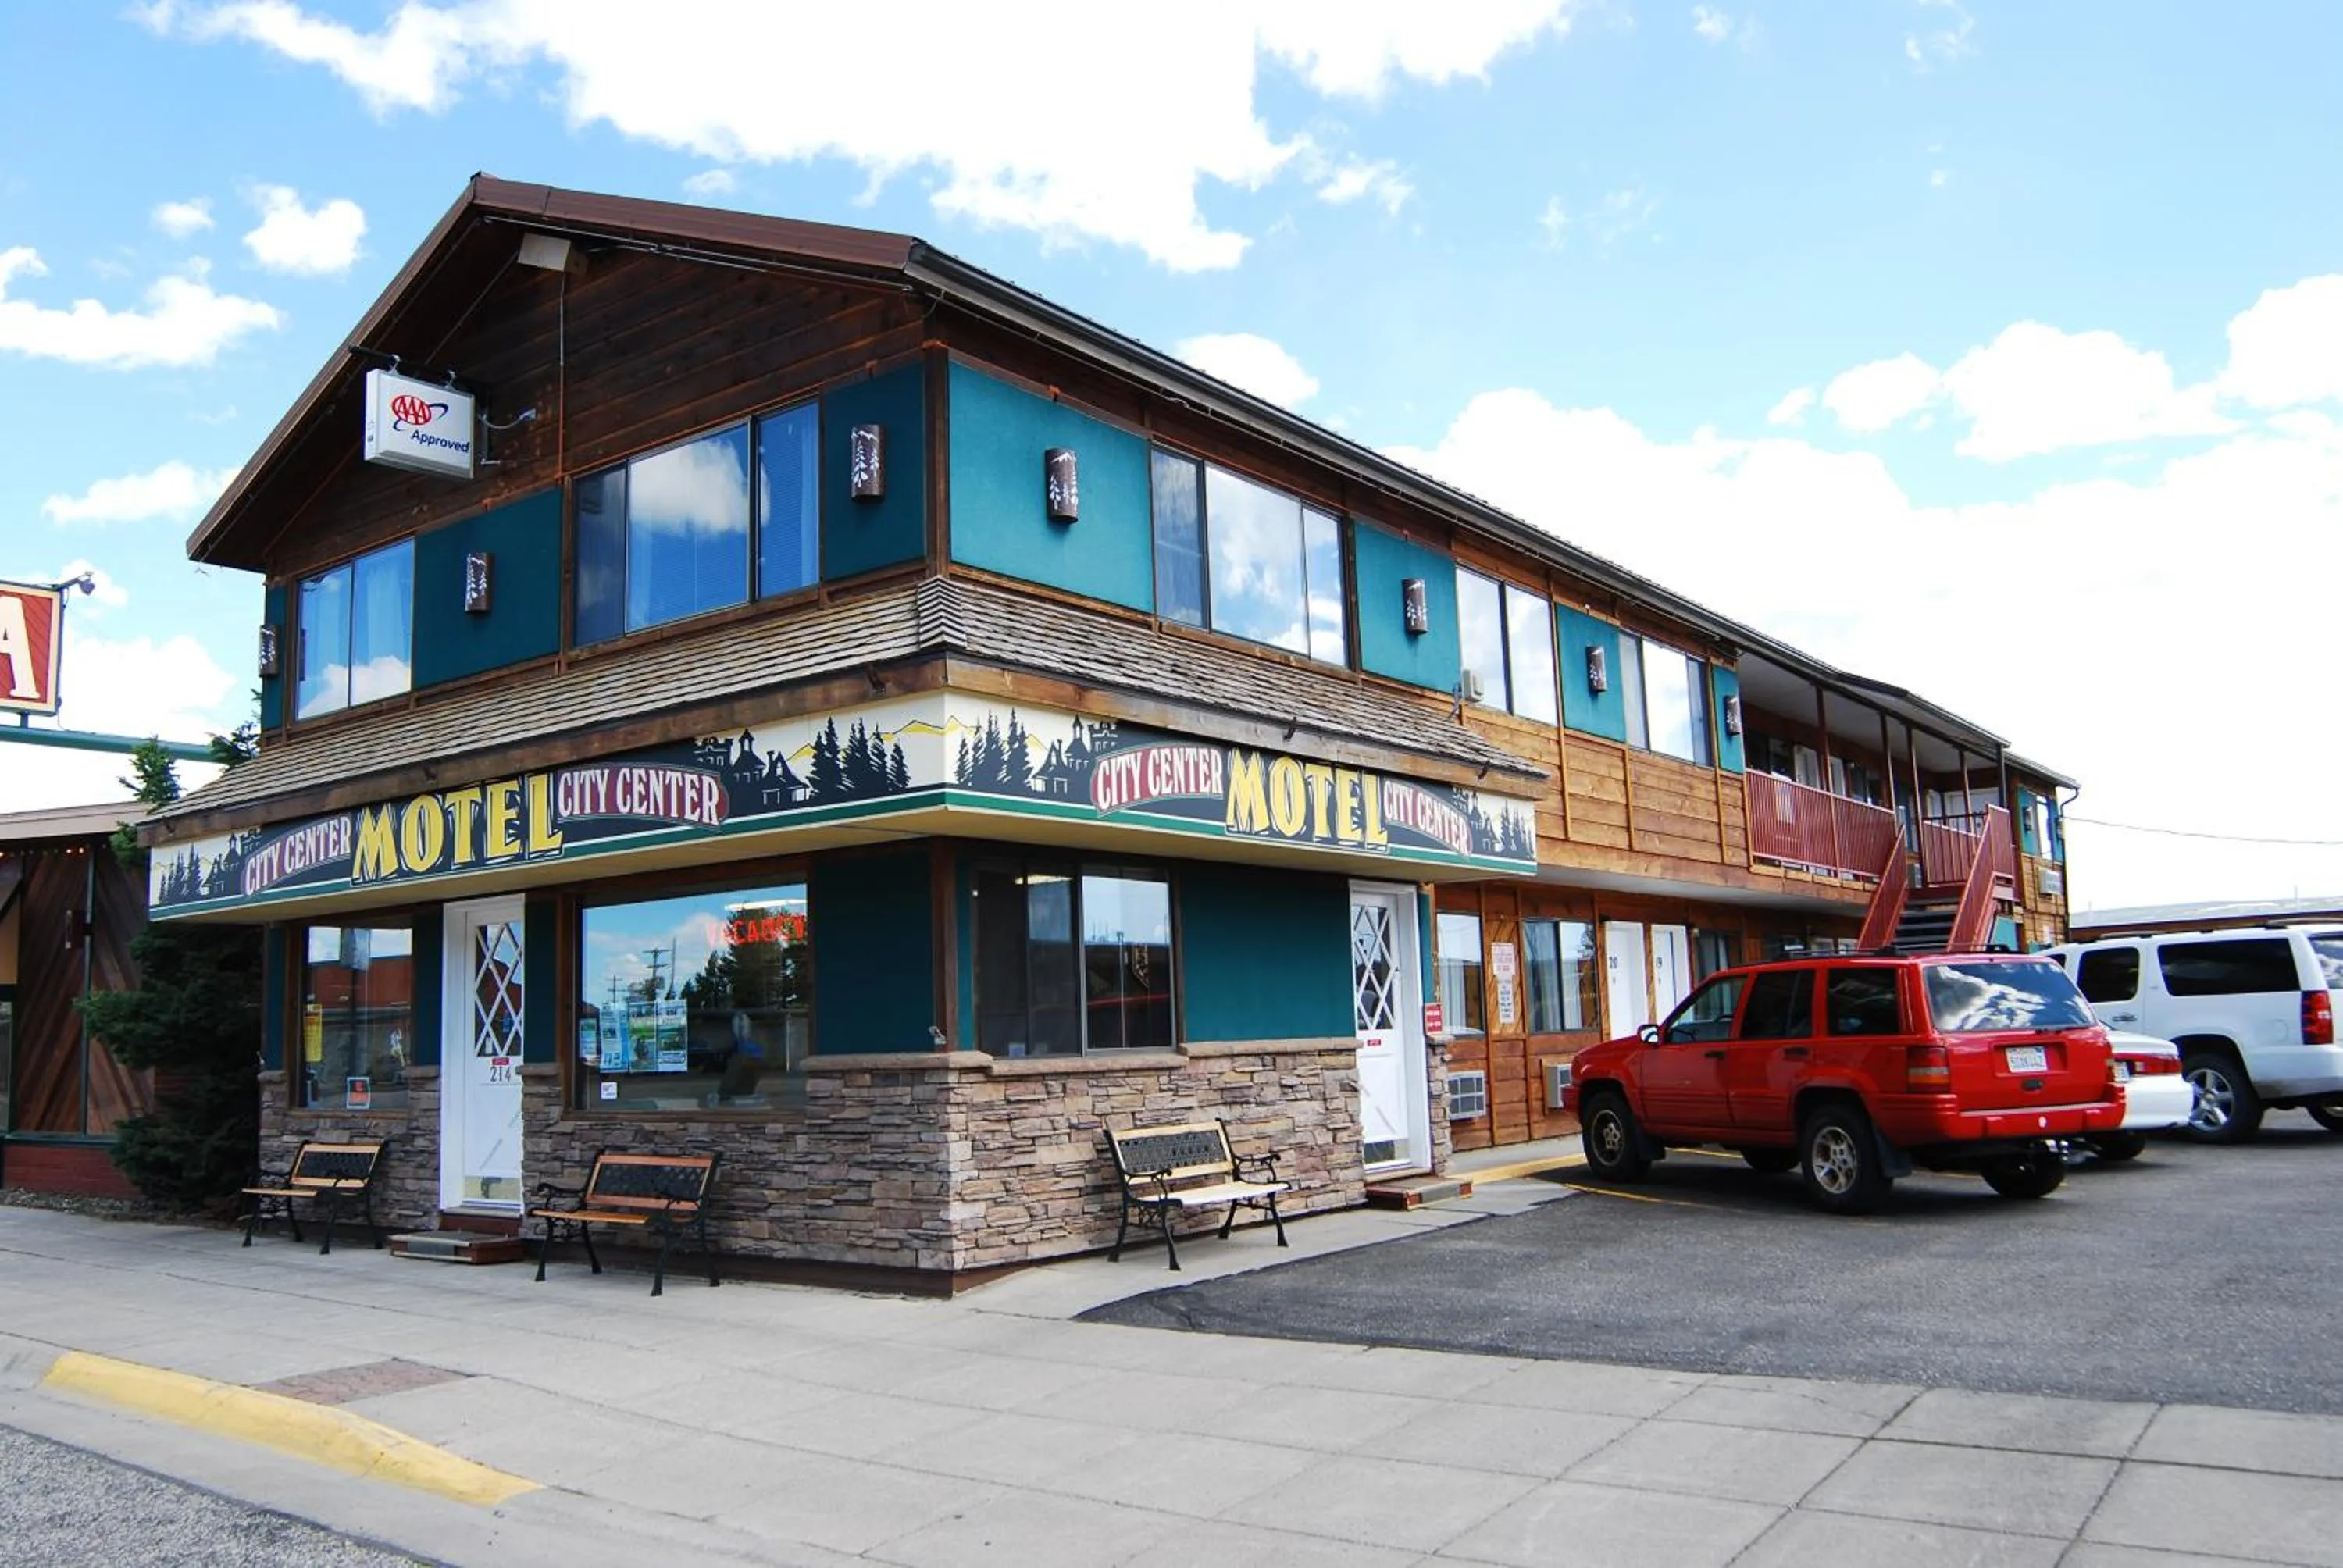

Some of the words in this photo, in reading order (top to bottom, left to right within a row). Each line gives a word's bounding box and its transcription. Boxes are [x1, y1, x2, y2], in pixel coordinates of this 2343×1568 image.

[397, 397, 429, 424] AAA
[411, 430, 471, 453] Approved
[558, 768, 609, 816] CITY
[615, 767, 721, 826] CENTER
[1096, 750, 1141, 811] CITY
[1147, 747, 1225, 796] CENTER
[1225, 750, 1389, 846] MOTEL
[353, 775, 563, 881] MOTEL
[1384, 779, 1414, 825] CITY
[1416, 793, 1469, 854] CENTER
[245, 845, 280, 896] CITY
[284, 816, 351, 876] CENTER
[490, 1065, 512, 1082] 214
